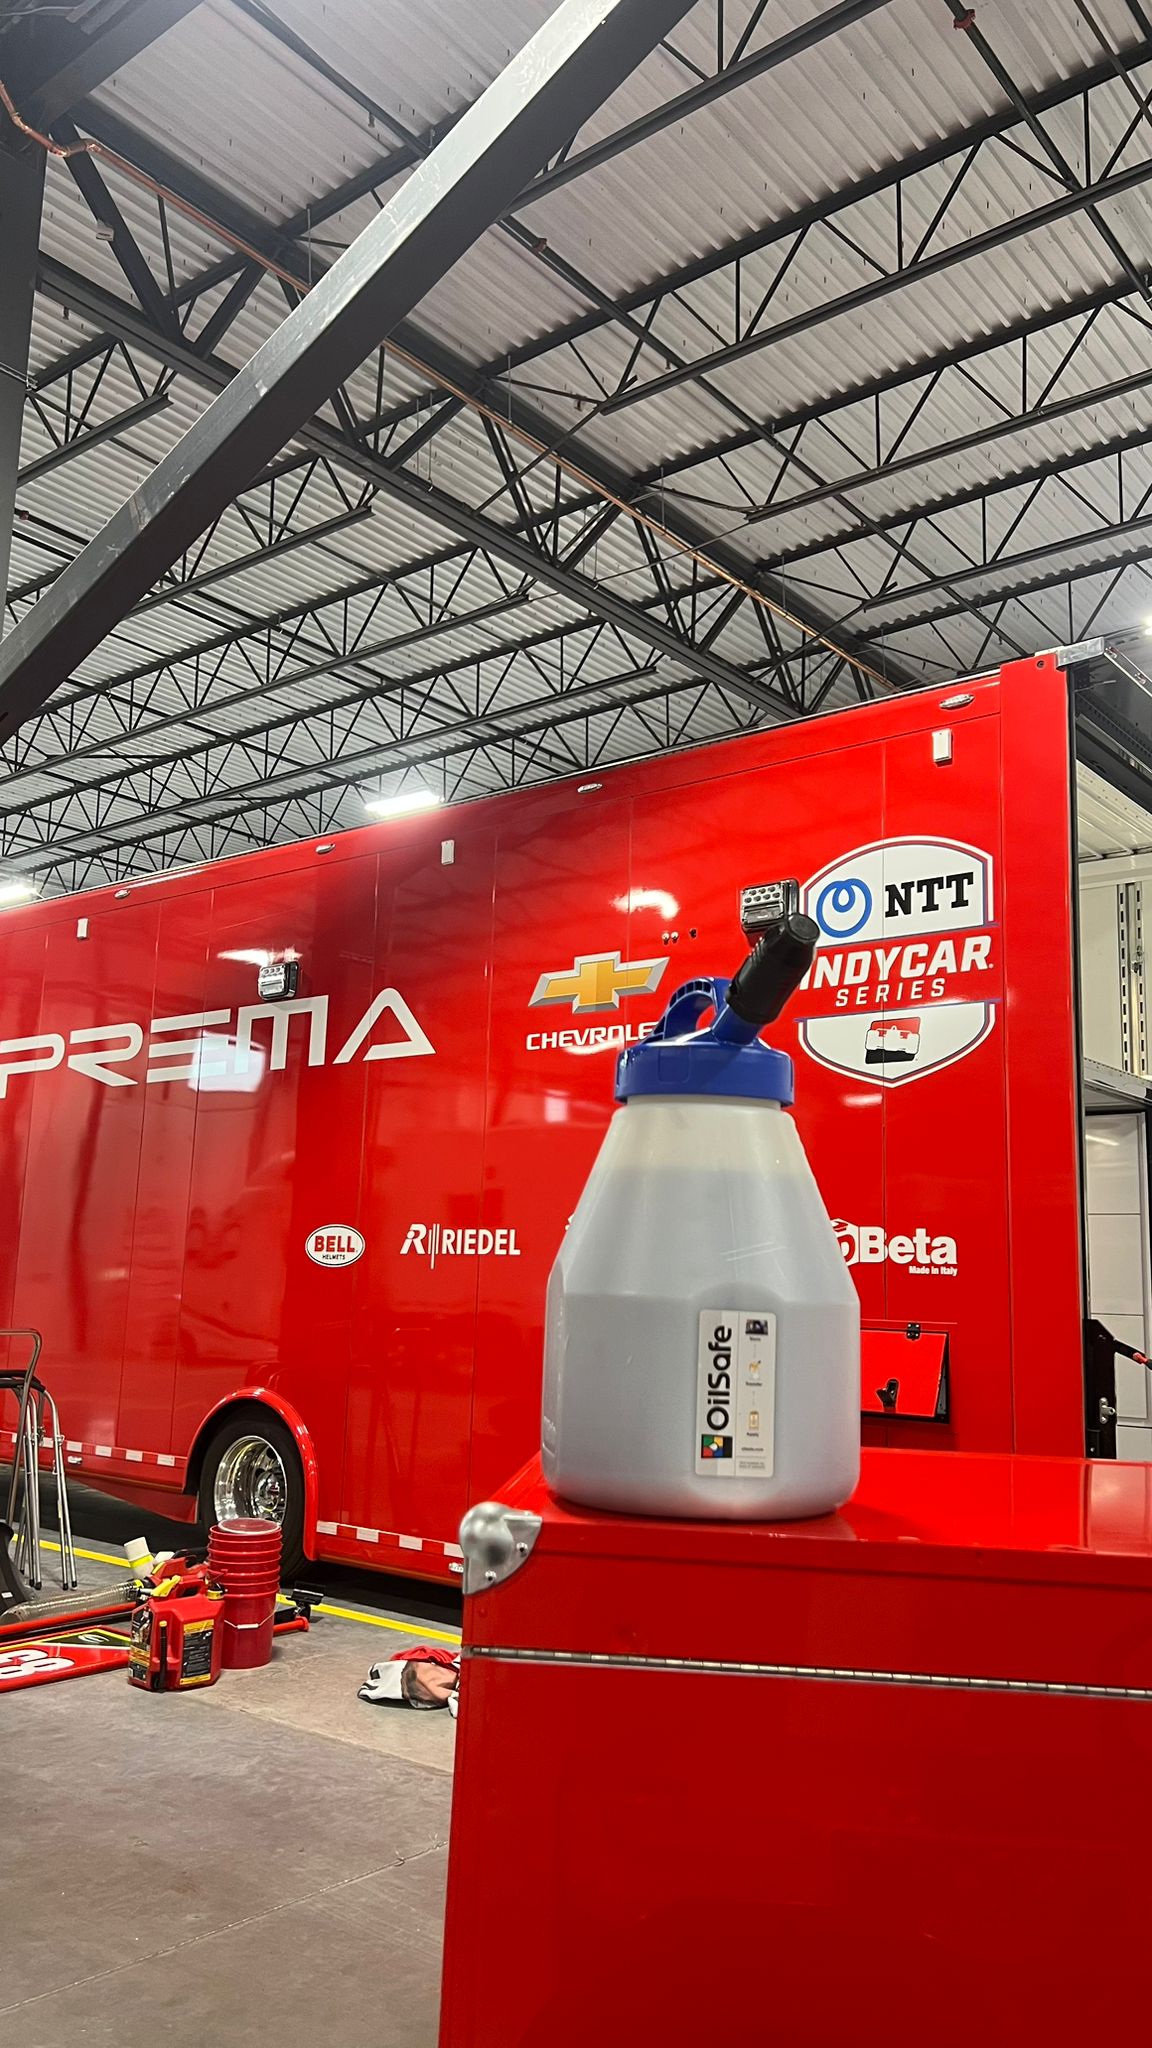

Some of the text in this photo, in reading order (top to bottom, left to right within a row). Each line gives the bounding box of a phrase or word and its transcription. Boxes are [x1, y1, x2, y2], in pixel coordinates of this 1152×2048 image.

[884, 871, 974, 918] NTT
[835, 978, 945, 1007] SERIES
[0, 987, 437, 1099] PREMA
[526, 1021, 659, 1051] CHEVROLE
[314, 1235, 355, 1252] BELL
[441, 1228, 521, 1256] RIEDEL
[859, 1226, 958, 1265] Beta
[908, 1265, 930, 1274] Made
[940, 1266, 958, 1277] Italy
[706, 1325, 732, 1431] OilSafe
